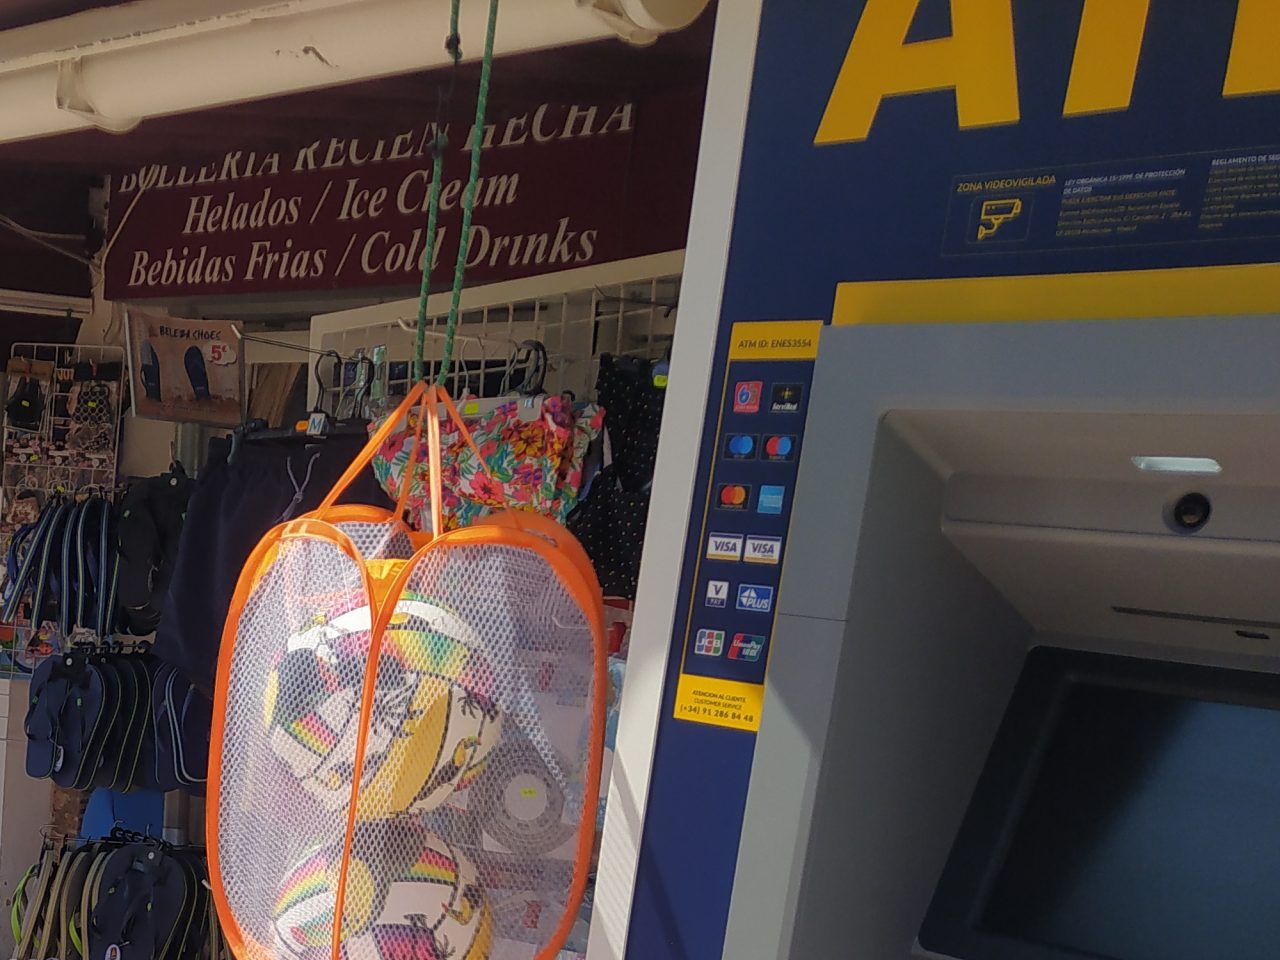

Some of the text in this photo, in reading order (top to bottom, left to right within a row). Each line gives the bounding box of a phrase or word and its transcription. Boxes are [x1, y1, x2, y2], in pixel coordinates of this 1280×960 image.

[957, 175, 1057, 193] ZONA VIDEOVIGILADA
[182, 187, 302, 234] Helados
[337, 178, 388, 221] Ice
[396, 169, 521, 214] Cream
[128, 245, 237, 287] Bebidas
[244, 239, 328, 281] Frias
[361, 226, 446, 275] Cold
[462, 216, 598, 269] Drinks
[738, 339, 759, 349] ATM
[759, 339, 769, 349] ID:
[713, 540, 737, 553] VISA
[751, 542, 775, 555] VISA
[712, 584, 723, 596] V
[746, 598, 769, 609] PLUS
[697, 637, 721, 649] JCB
[680, 703, 755, 723] (+34) 91 286 84 48
